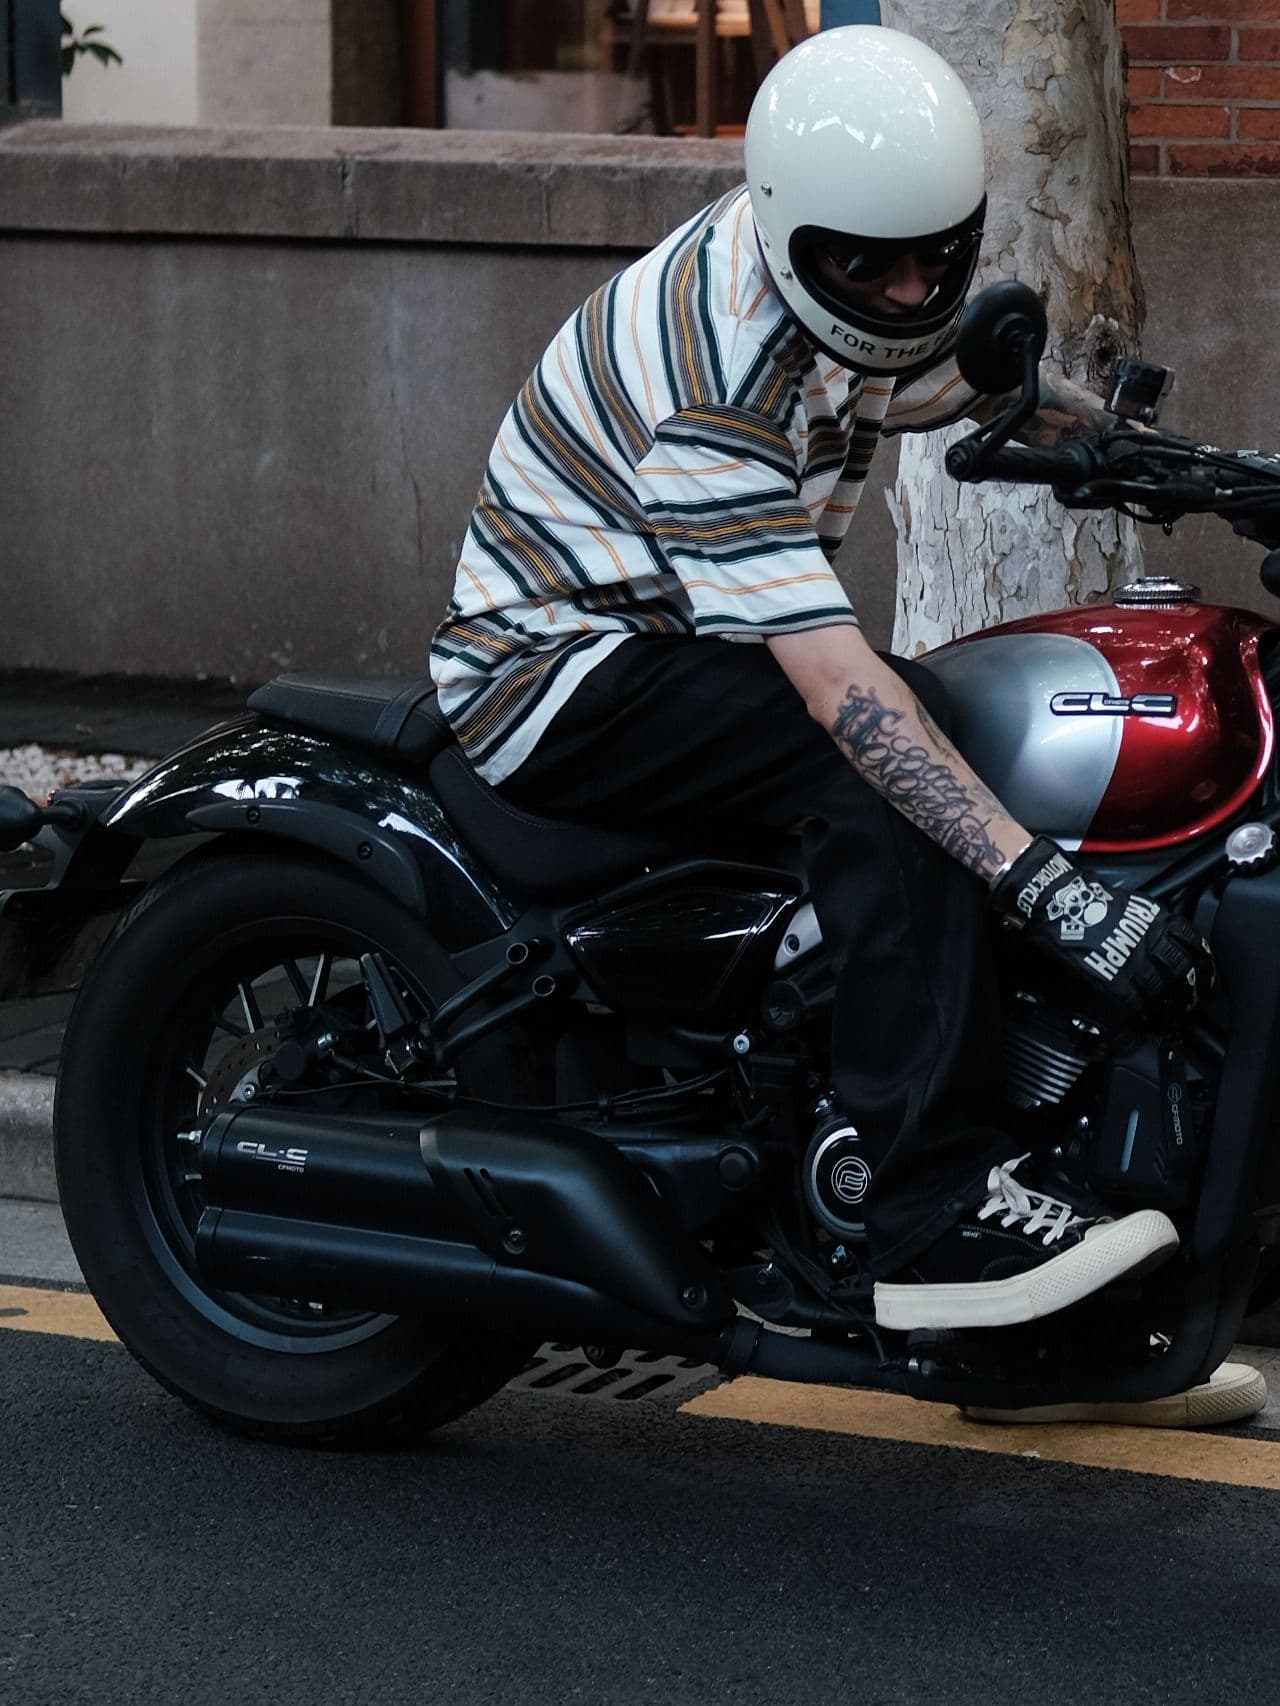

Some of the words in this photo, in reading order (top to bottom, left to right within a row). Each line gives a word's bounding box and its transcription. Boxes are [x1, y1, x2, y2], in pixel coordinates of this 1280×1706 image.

[830, 324, 876, 355] FOR
[884, 343, 928, 359] THE
[1084, 895, 1161, 981] TRIUMPH
